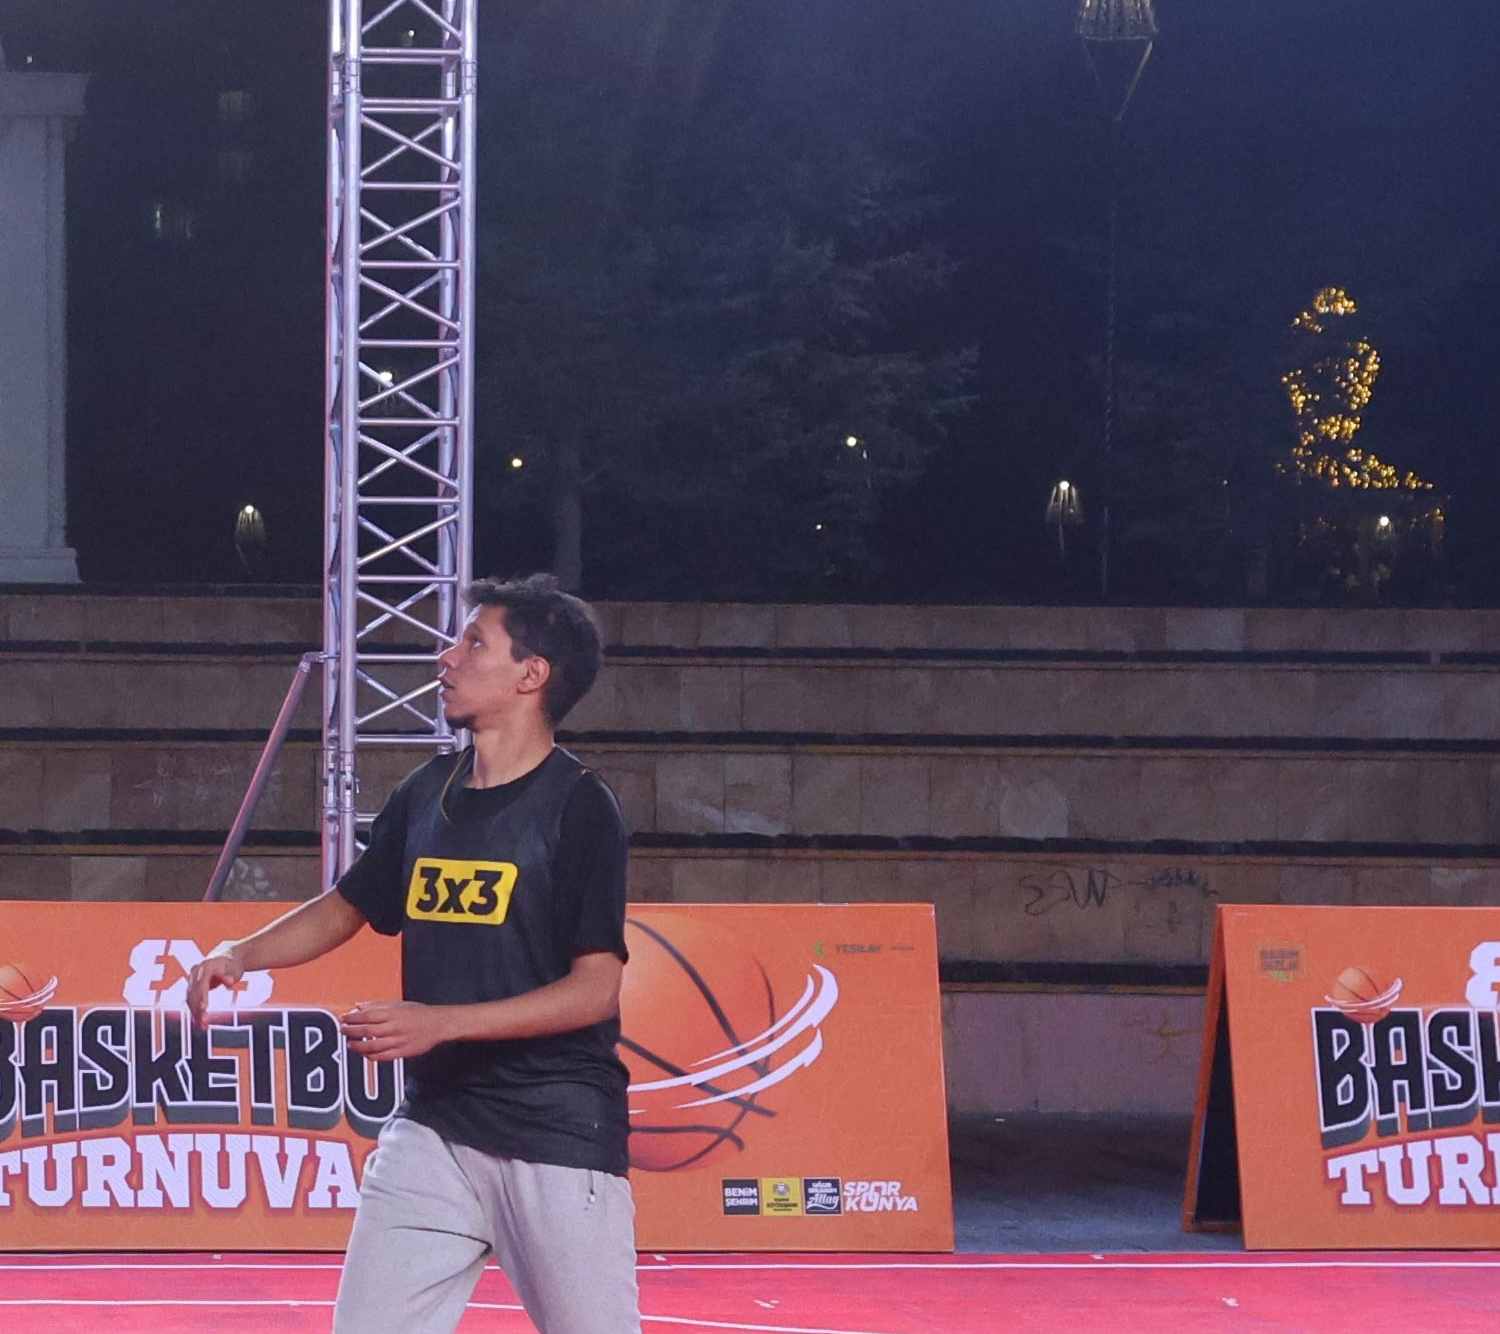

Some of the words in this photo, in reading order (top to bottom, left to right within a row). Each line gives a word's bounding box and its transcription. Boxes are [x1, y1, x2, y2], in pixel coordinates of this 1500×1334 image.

[416, 867, 503, 916] 3x3
[843, 1181, 901, 1197] SPOR
[845, 1192, 918, 1212] KONYA
